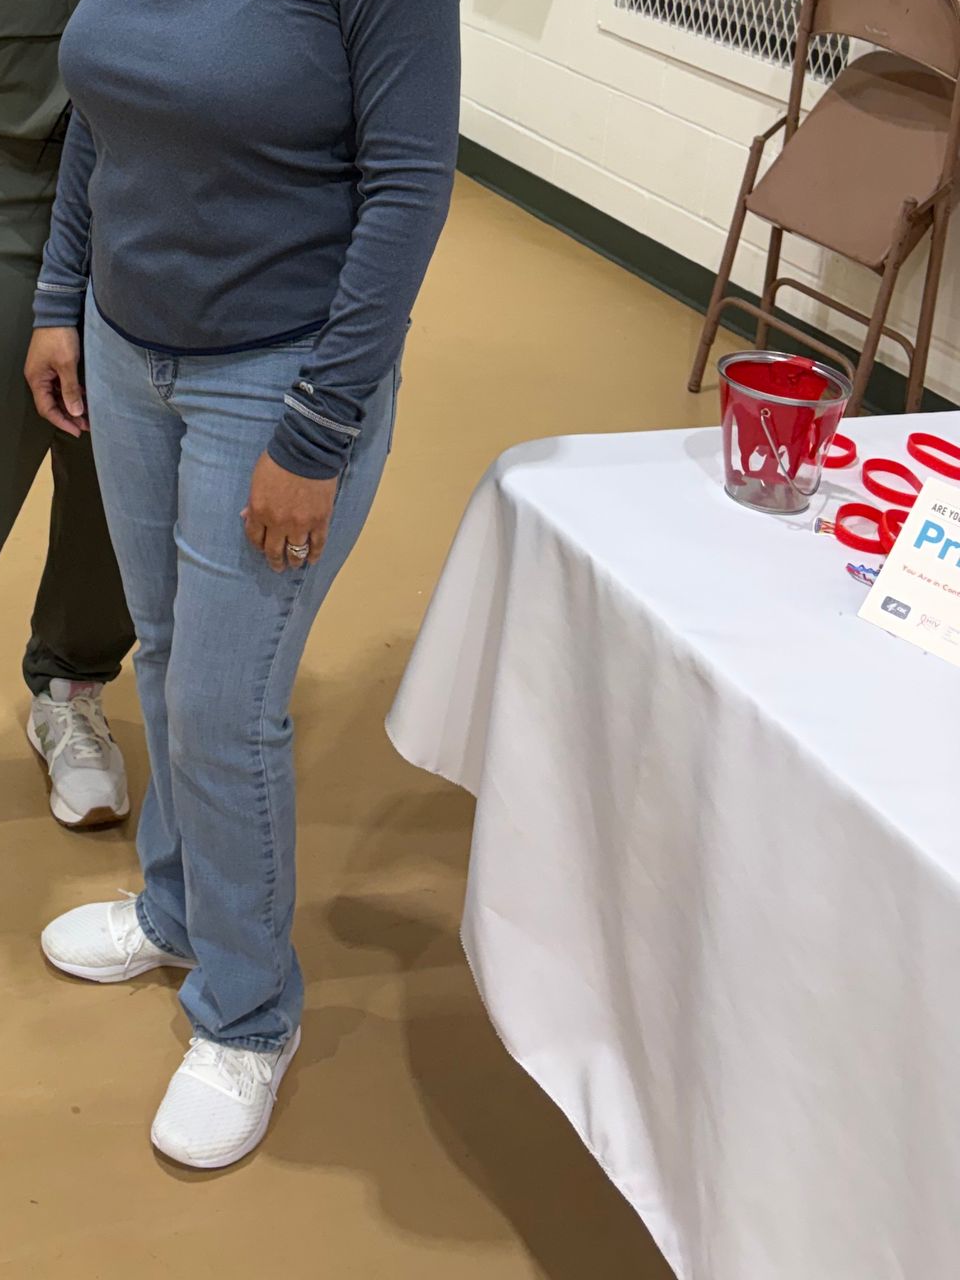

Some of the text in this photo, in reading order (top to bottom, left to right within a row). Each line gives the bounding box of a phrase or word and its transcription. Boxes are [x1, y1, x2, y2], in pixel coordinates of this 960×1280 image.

[931, 504, 948, 516] ARE
[913, 519, 960, 569] Pr
[918, 573, 932, 584] Are
